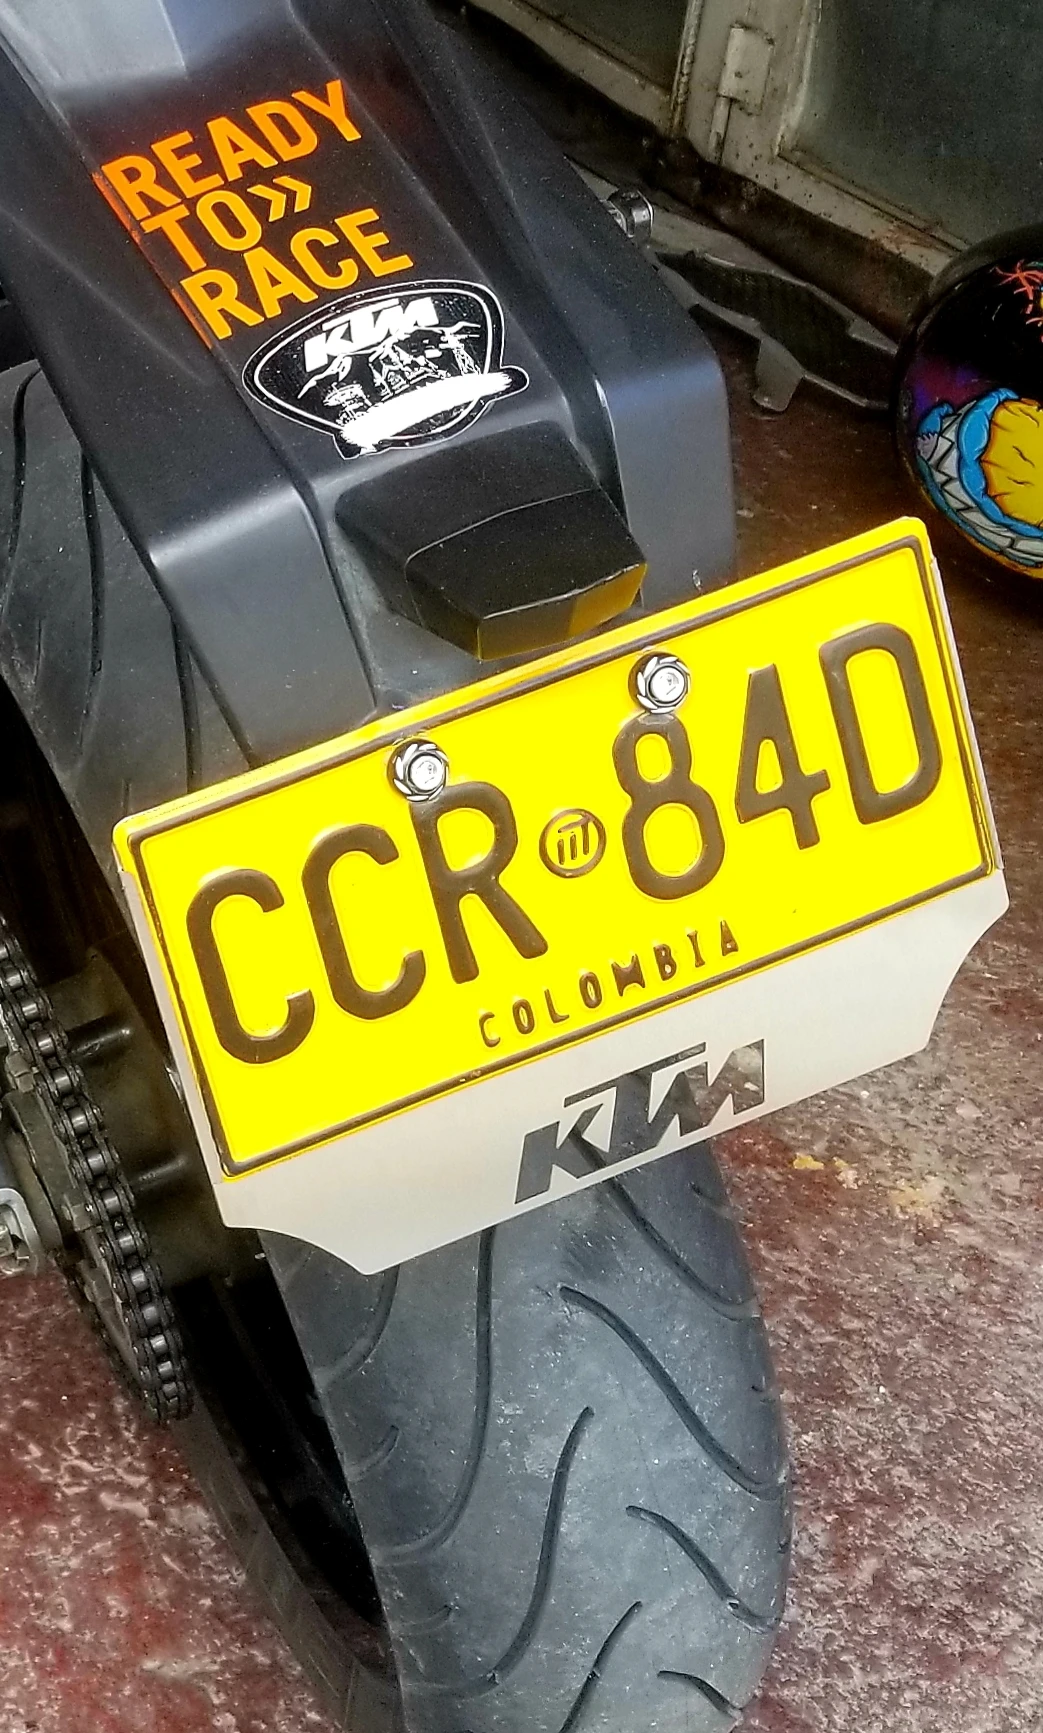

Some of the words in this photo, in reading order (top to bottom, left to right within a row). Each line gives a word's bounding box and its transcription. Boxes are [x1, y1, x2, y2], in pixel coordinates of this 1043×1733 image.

[102, 79, 361, 220] READY
[140, 189, 262, 273] TO
[180, 208, 413, 340] RACE
[304, 297, 440, 372] KTM
[186, 781, 548, 1065] CCR
[611, 622, 943, 900] 84D
[480, 919, 740, 1047] COLOMBIA
[515, 1038, 765, 1204] KTM
